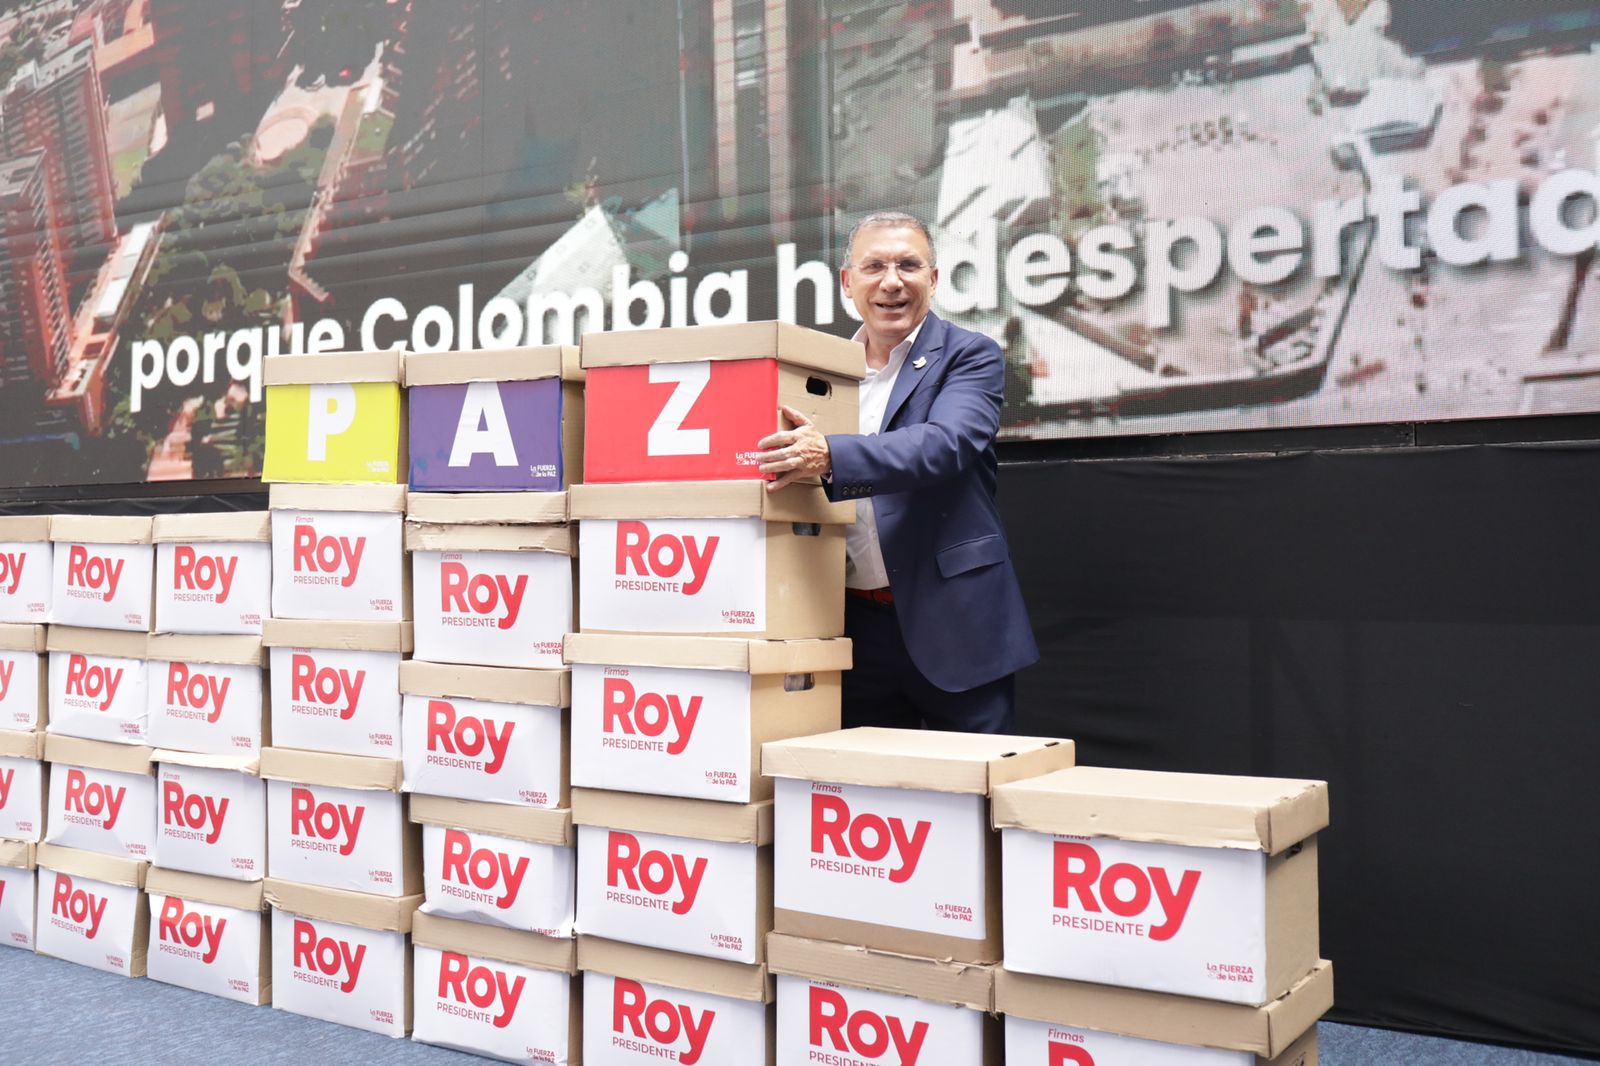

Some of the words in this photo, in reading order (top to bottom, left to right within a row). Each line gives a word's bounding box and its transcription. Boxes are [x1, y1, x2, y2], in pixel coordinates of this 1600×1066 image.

[129, 318, 345, 413] porque
[360, 250, 749, 352] Colombia
[777, 243, 863, 325] h
[307, 383, 356, 461] P
[448, 381, 519, 467] A
[647, 360, 710, 456] Z
[68, 545, 124, 602] Roy
[175, 546, 238, 603] Roy
[294, 525, 365, 587] Roy
[294, 575, 340, 585] PRESIDENTE
[616, 520, 720, 596] Roy
[441, 562, 528, 629] Roy
[615, 580, 679, 593] PRESIDENTE
[441, 616, 495, 628] PRESIDENTE
[66, 654, 123, 711] Roy
[168, 661, 231, 723] Roy
[292, 654, 366, 720] Roy
[604, 667, 629, 677] Firmas
[292, 705, 338, 718] PRESIDENTE
[427, 700, 515, 774] Roy
[604, 678, 703, 755] Roy
[427, 755, 482, 771] PRESIDENTE
[603, 738, 664, 752] PRESIDENTE
[65, 769, 126, 830] Roy
[164, 781, 229, 844] Roy
[812, 782, 842, 793] Firmas
[164, 828, 204, 841] PRESIDENTE
[291, 839, 337, 853] PRESIDENTE
[292, 788, 365, 856] Roy
[811, 792, 932, 883] Roy
[441, 884, 493, 905] PRESIDENTE
[443, 829, 529, 909] Roy
[608, 831, 708, 915] Roy
[810, 858, 885, 879] PRESIDENTE
[1053, 841, 1201, 941] Roy
[53, 874, 107, 939] Roy
[160, 896, 227, 964] Roy
[607, 892, 669, 911] PRESIDENTE
[935, 903, 943, 911] La
[945, 904, 972, 914] FUERZA
[1052, 914, 1144, 936] PRESIDENTE
[160, 944, 201, 960] PRESIDENTE
[294, 920, 366, 993] Roy
[294, 971, 338, 990] PRESIDENTE
[1206, 962, 1217, 971] La
[1219, 964, 1253, 974] FUERZA
[437, 1002, 491, 1024] PRESIDENTE
[438, 951, 526, 1028] Roy
[612, 1037, 676, 1061] PRESIDENTE
[613, 977, 715, 1066] Roy
[809, 986, 929, 1066] Roy
[1048, 1028, 1084, 1043] Firmas
